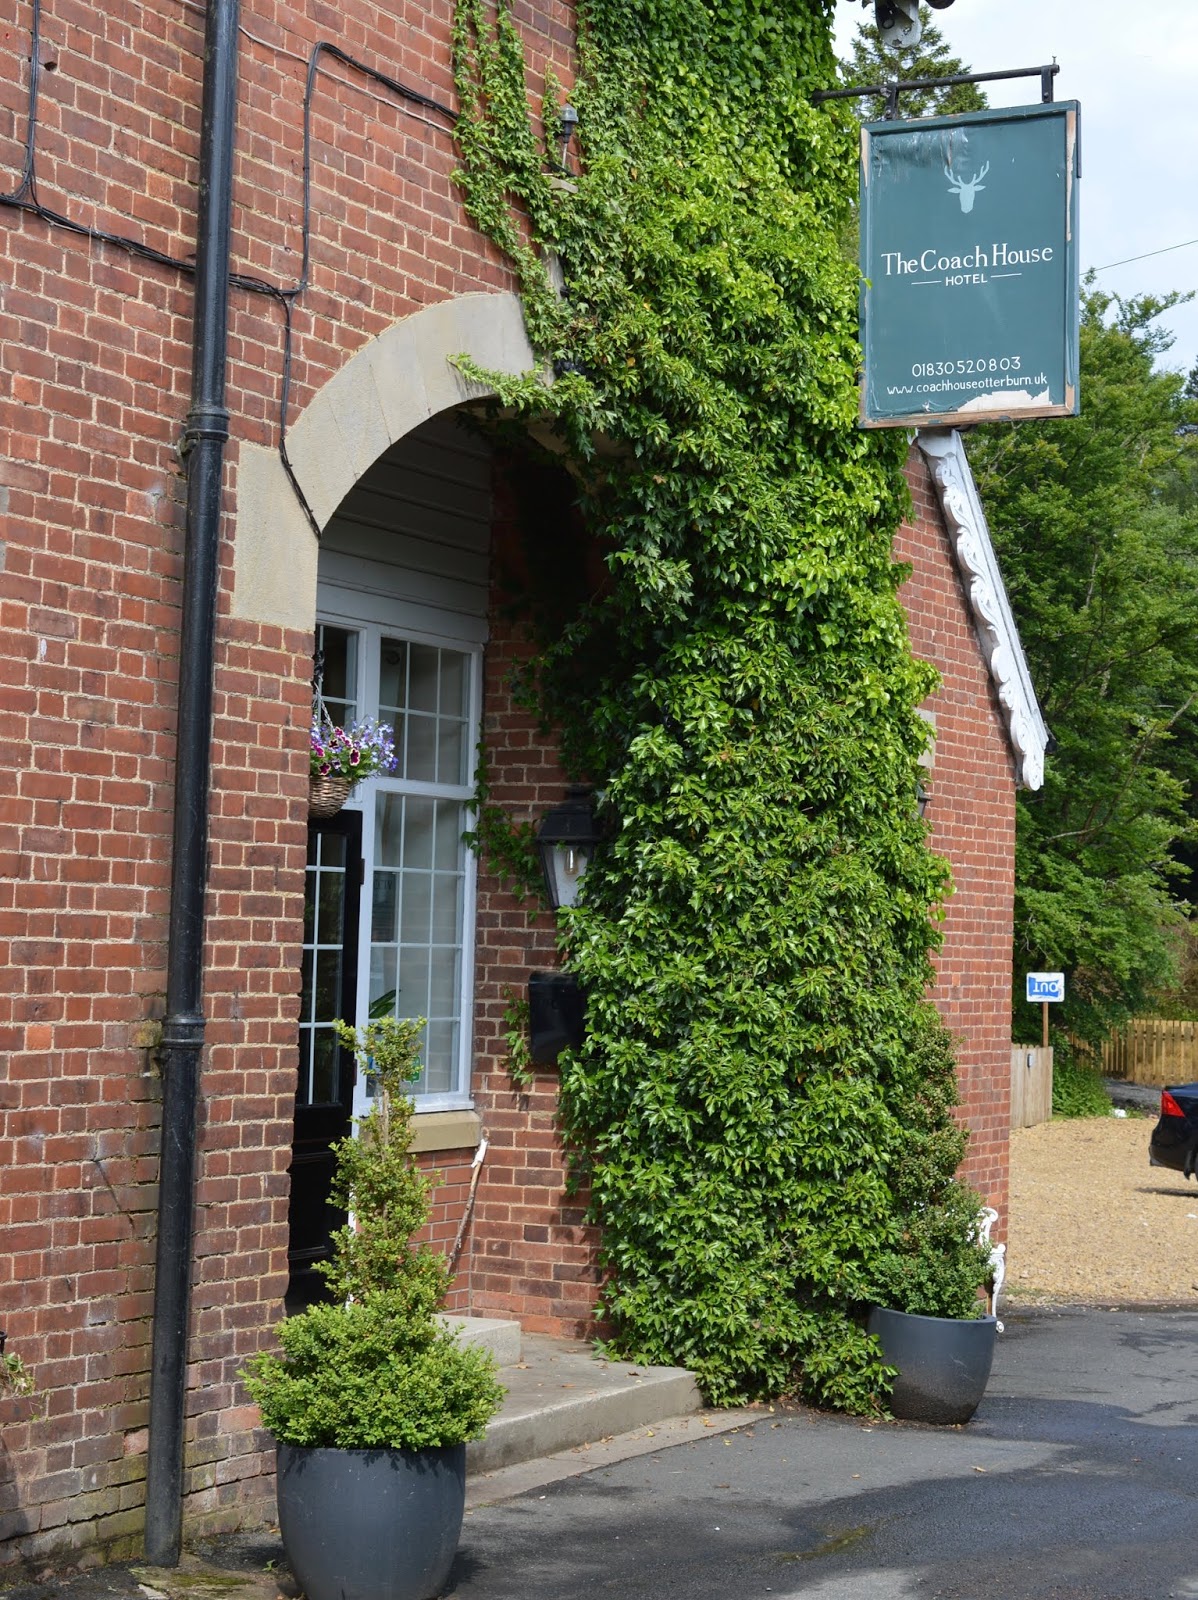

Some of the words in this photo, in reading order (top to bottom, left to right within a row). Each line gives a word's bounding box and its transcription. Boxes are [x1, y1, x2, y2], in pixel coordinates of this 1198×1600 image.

[881, 252, 918, 275] The
[920, 245, 988, 272] Coach
[992, 243, 1053, 266] House
[945, 273, 988, 286] HOTEL
[886, 372, 1048, 395] www.coachhouseotterburn.uk
